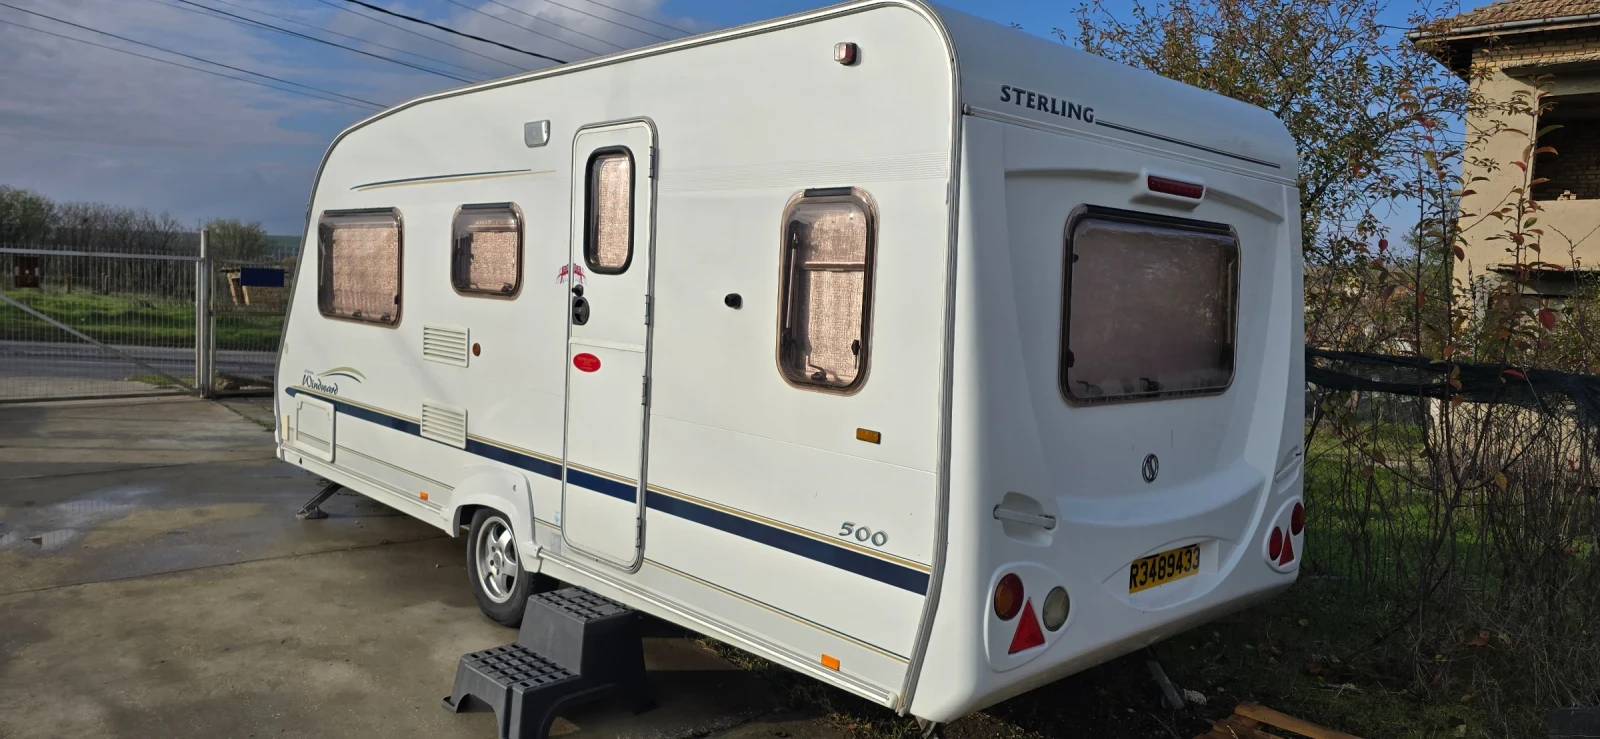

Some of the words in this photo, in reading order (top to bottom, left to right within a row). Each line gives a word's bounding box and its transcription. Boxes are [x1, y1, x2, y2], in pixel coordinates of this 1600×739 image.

[1000, 84, 1094, 123] STERLING
[302, 374, 339, 395] Windward
[838, 521, 889, 547] 500
[1129, 547, 1200, 590] R3489433
